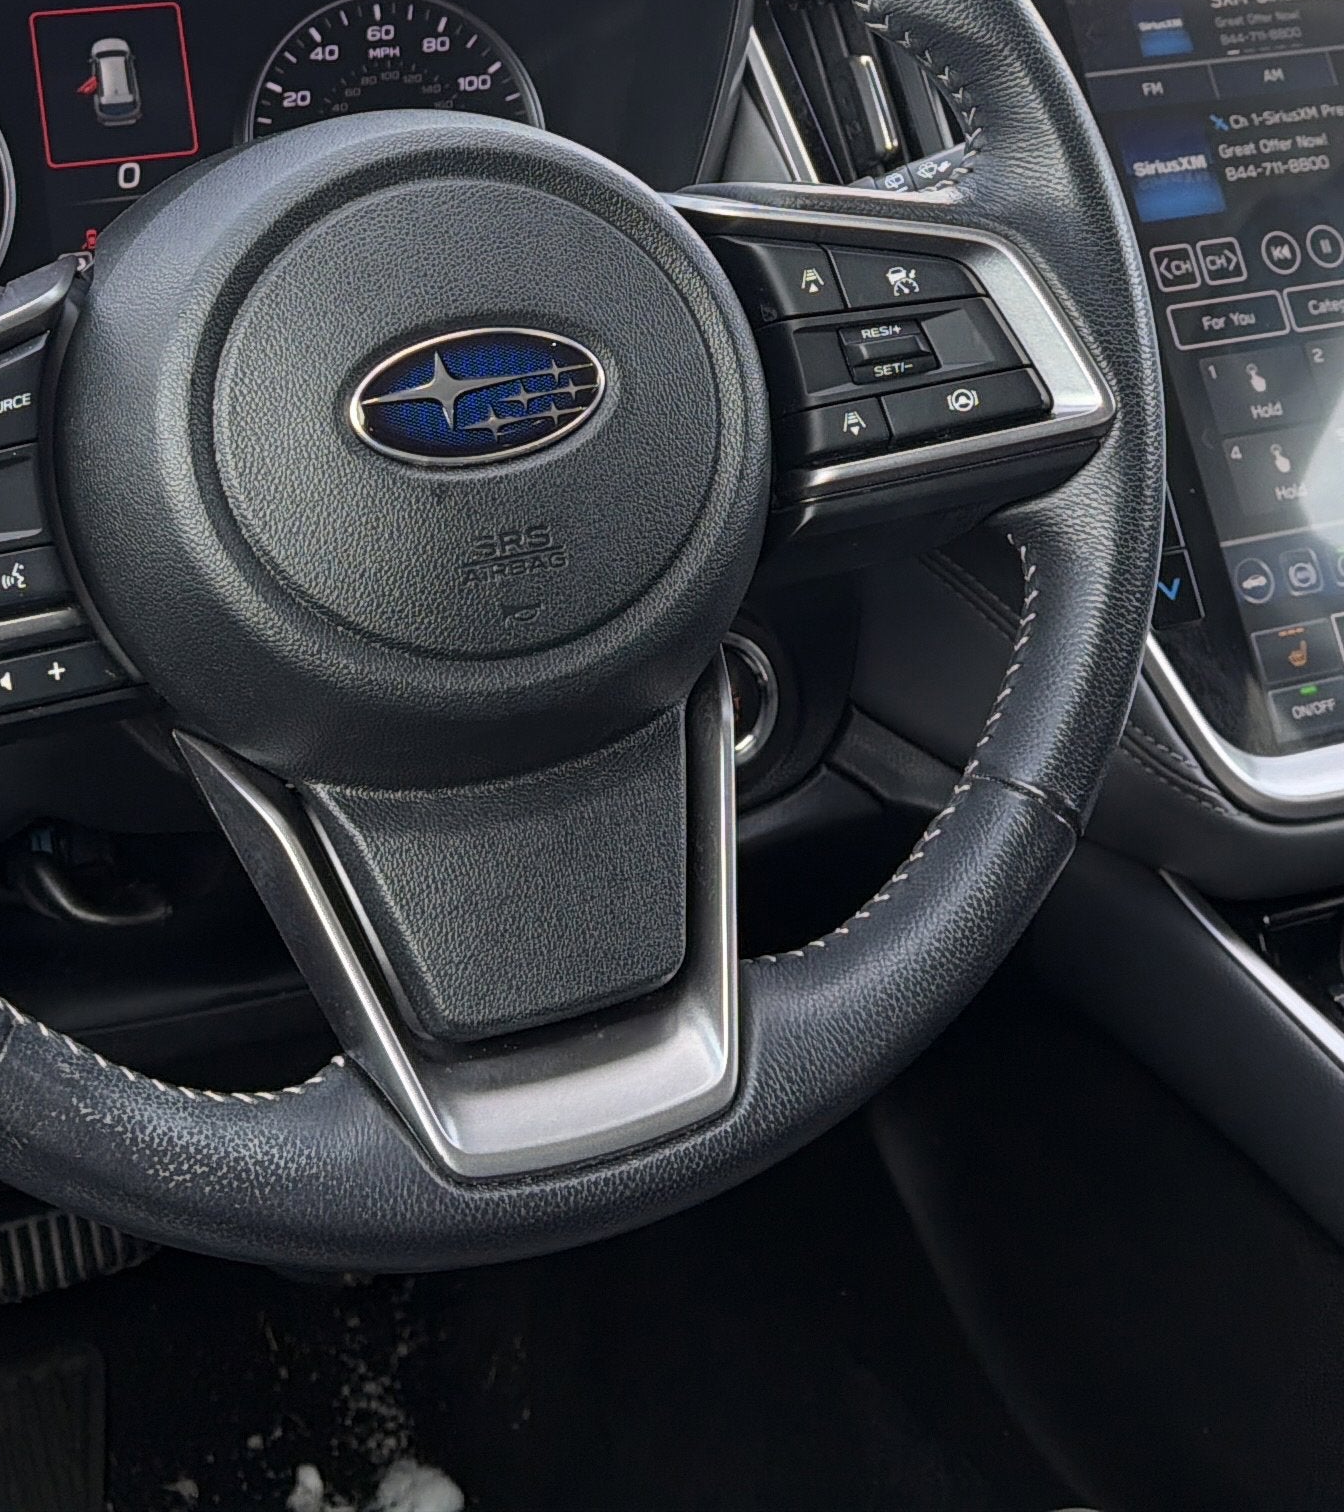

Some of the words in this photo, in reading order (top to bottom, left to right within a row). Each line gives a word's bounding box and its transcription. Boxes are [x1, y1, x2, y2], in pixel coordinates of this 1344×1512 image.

[366, 24, 395, 41] 60
[309, 44, 340, 62] 40
[367, 45, 401, 60] MPH
[422, 36, 451, 54] 80
[380, 69, 400, 83] 100
[457, 74, 492, 92] 100
[1262, 67, 1285, 83] AM
[1142, 81, 1164, 97] FM
[282, 89, 312, 108] 20
[1218, 141, 1257, 159] Great
[1259, 136, 1293, 155] Offer
[1132, 154, 1208, 178] SiriusXM
[1170, 260, 1193, 277] CH
[1205, 253, 1227, 270] CH
[1201, 315, 1226, 331] For
[1229, 310, 1256, 327] You
[1311, 348, 1325, 363] 2
[1251, 402, 1283, 420] Hold
[1229, 445, 1243, 461] 4
[1275, 484, 1307, 501] Hold
[1291, 697, 1336, 720] ON/OFF
